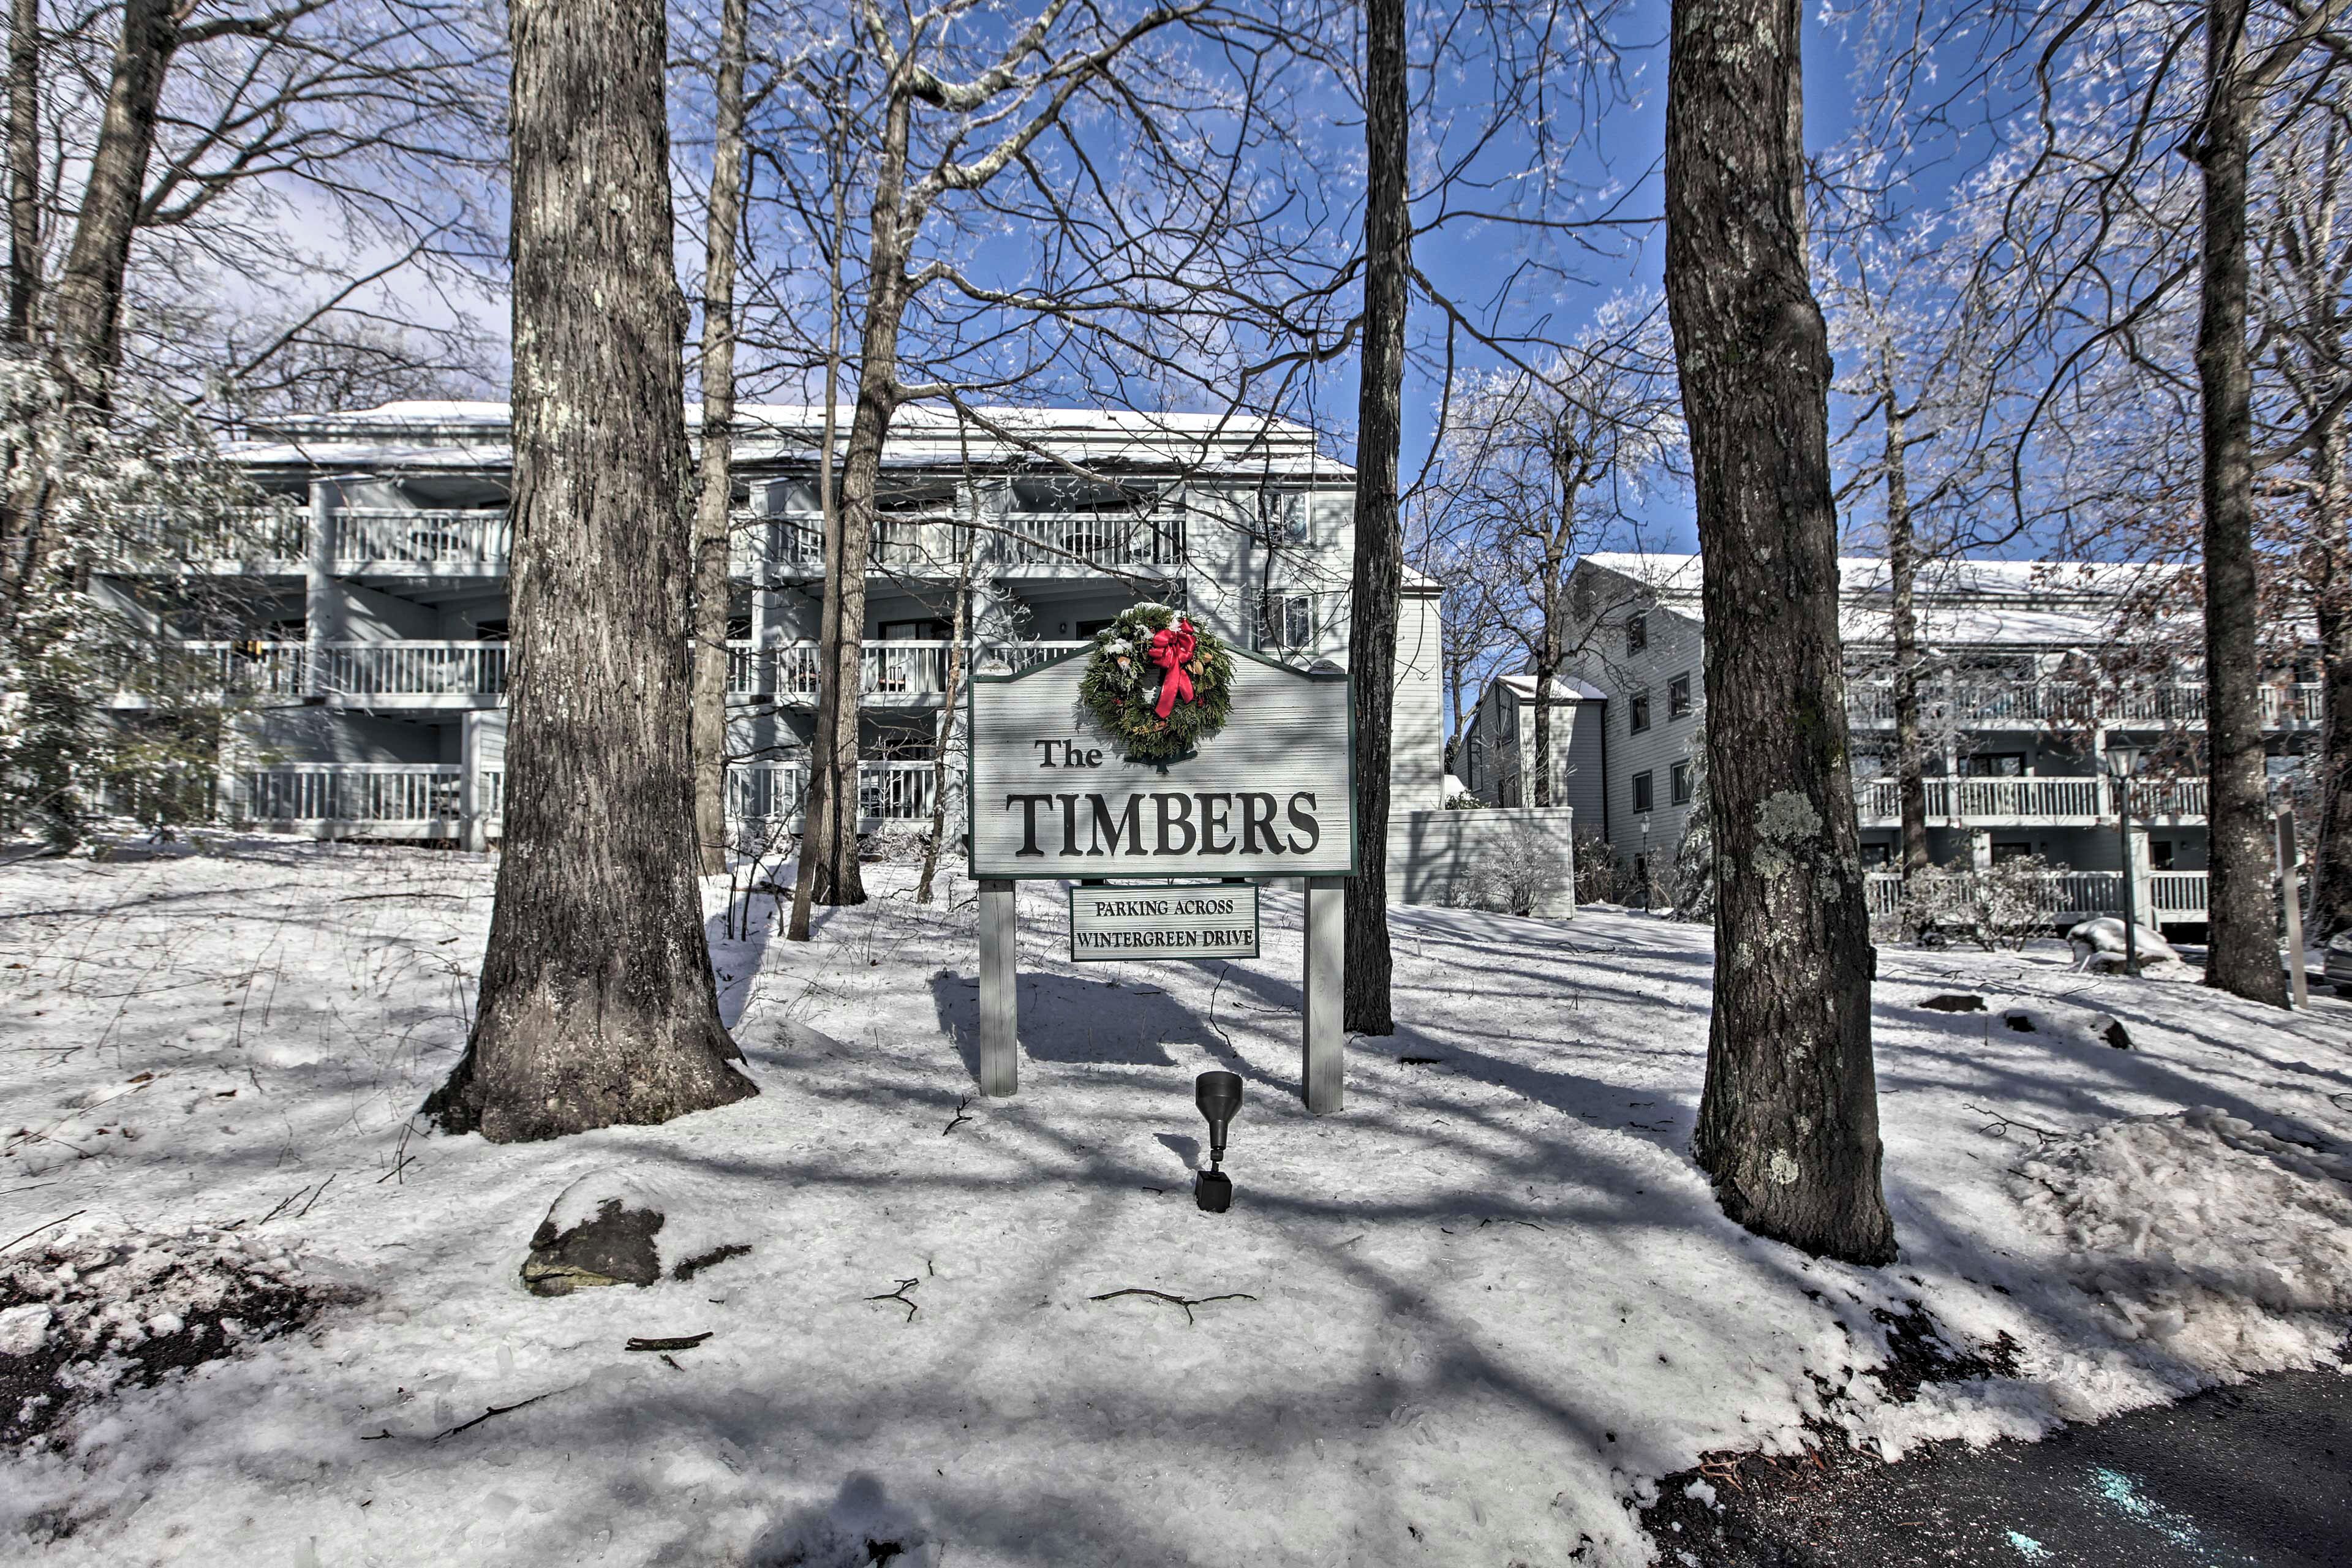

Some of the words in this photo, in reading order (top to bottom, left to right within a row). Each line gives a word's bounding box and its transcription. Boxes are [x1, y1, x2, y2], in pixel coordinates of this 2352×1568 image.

[1034, 739, 1103, 768] The
[1006, 791, 1320, 857] TIMBERS
[1095, 900, 1168, 916] PARKING
[1174, 899, 1234, 915] ACROSS
[1076, 930, 1197, 948] WINTERGREEN
[1202, 929, 1254, 947] DRIVE
